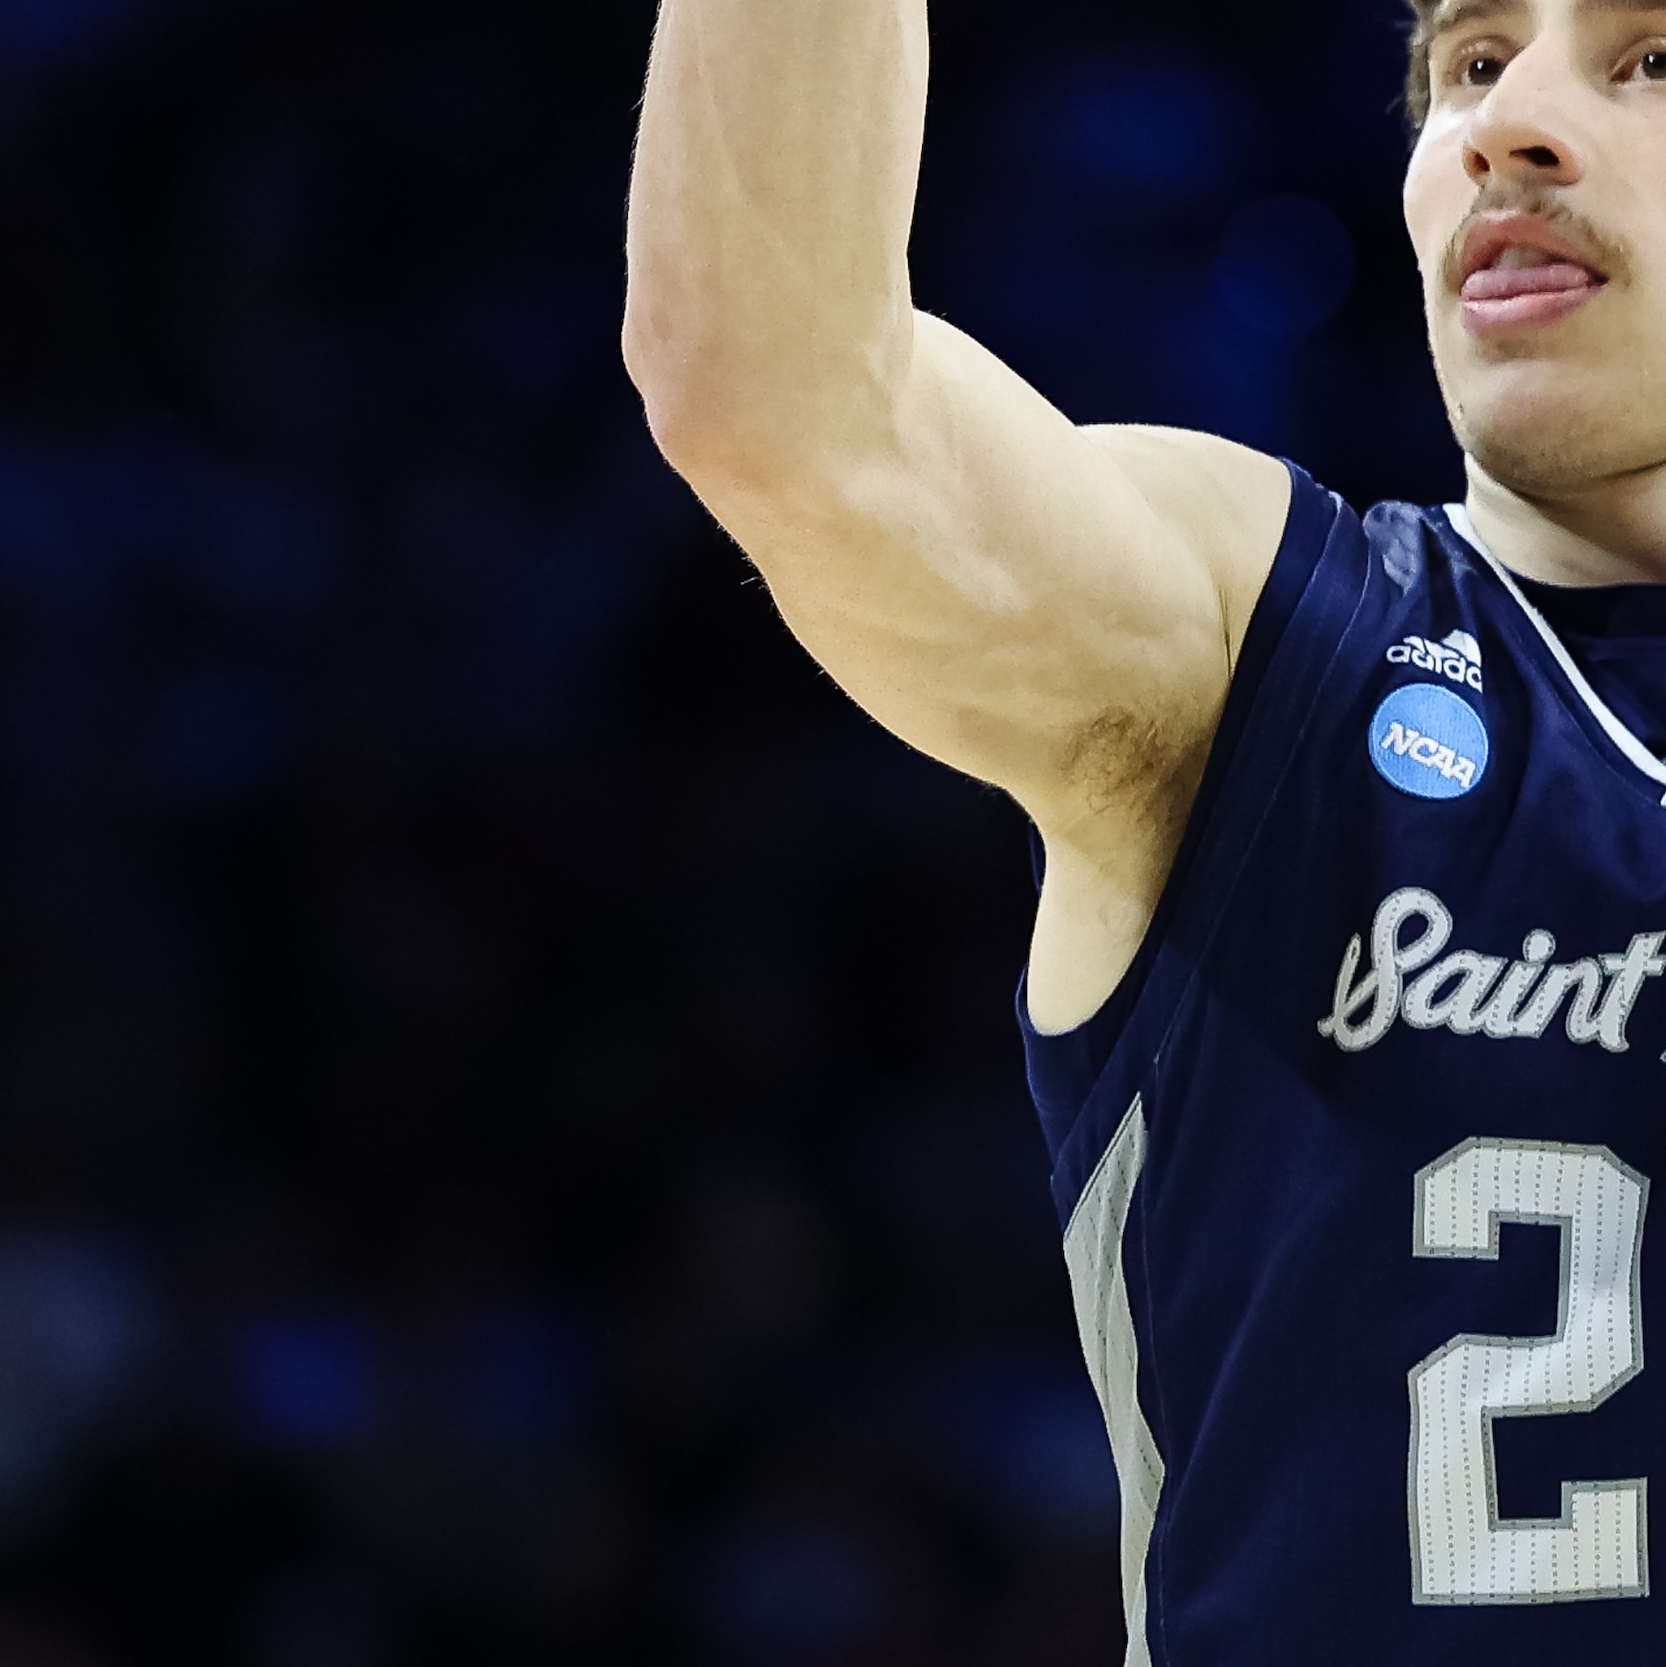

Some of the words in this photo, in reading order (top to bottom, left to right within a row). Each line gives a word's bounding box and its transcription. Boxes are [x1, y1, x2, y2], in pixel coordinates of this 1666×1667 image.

[1386, 638, 1484, 694] adida
[1381, 721, 1477, 790] NCAA
[1317, 885, 1666, 1052] Saint
